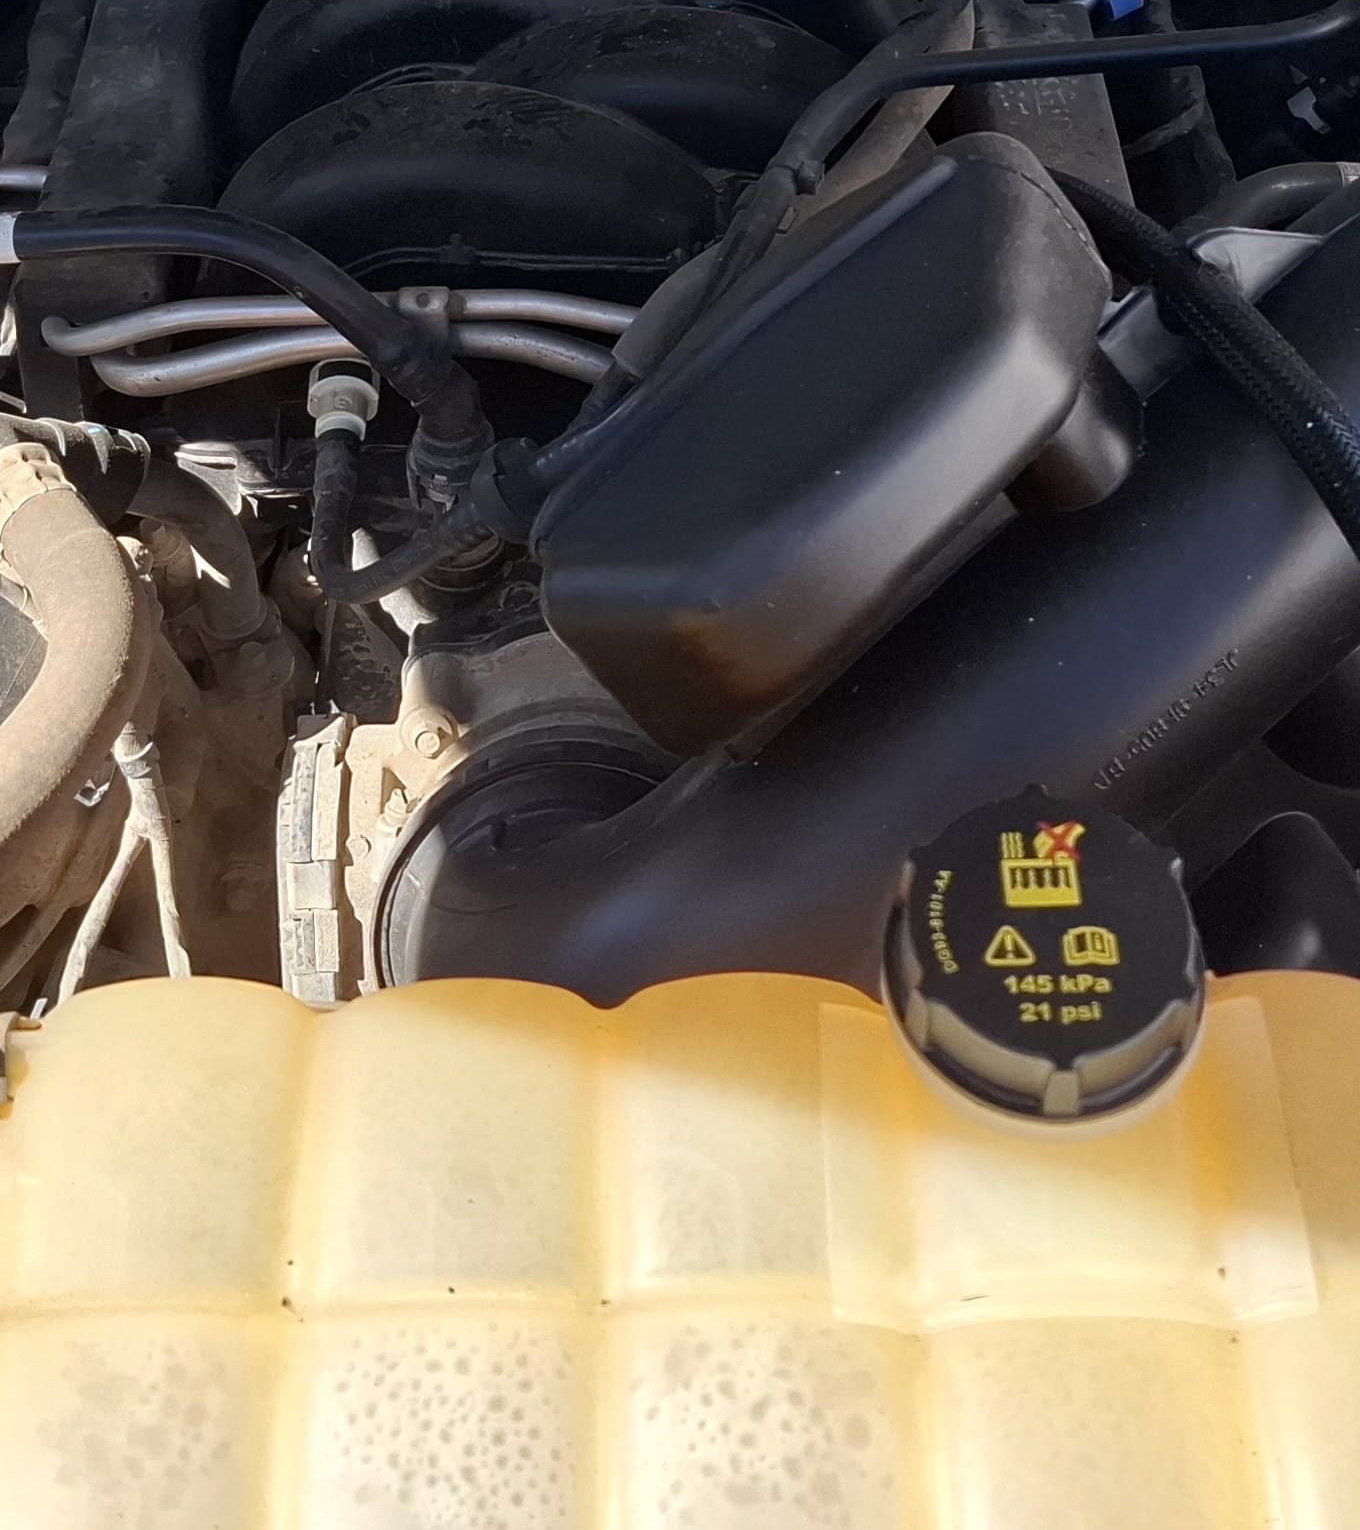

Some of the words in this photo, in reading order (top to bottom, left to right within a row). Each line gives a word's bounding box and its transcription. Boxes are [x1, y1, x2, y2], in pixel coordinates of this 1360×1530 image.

[1003, 974, 1055, 995] 145
[1060, 973, 1113, 995] kPa
[1018, 1002, 1051, 1023] 21
[1060, 1001, 1103, 1025] psi
